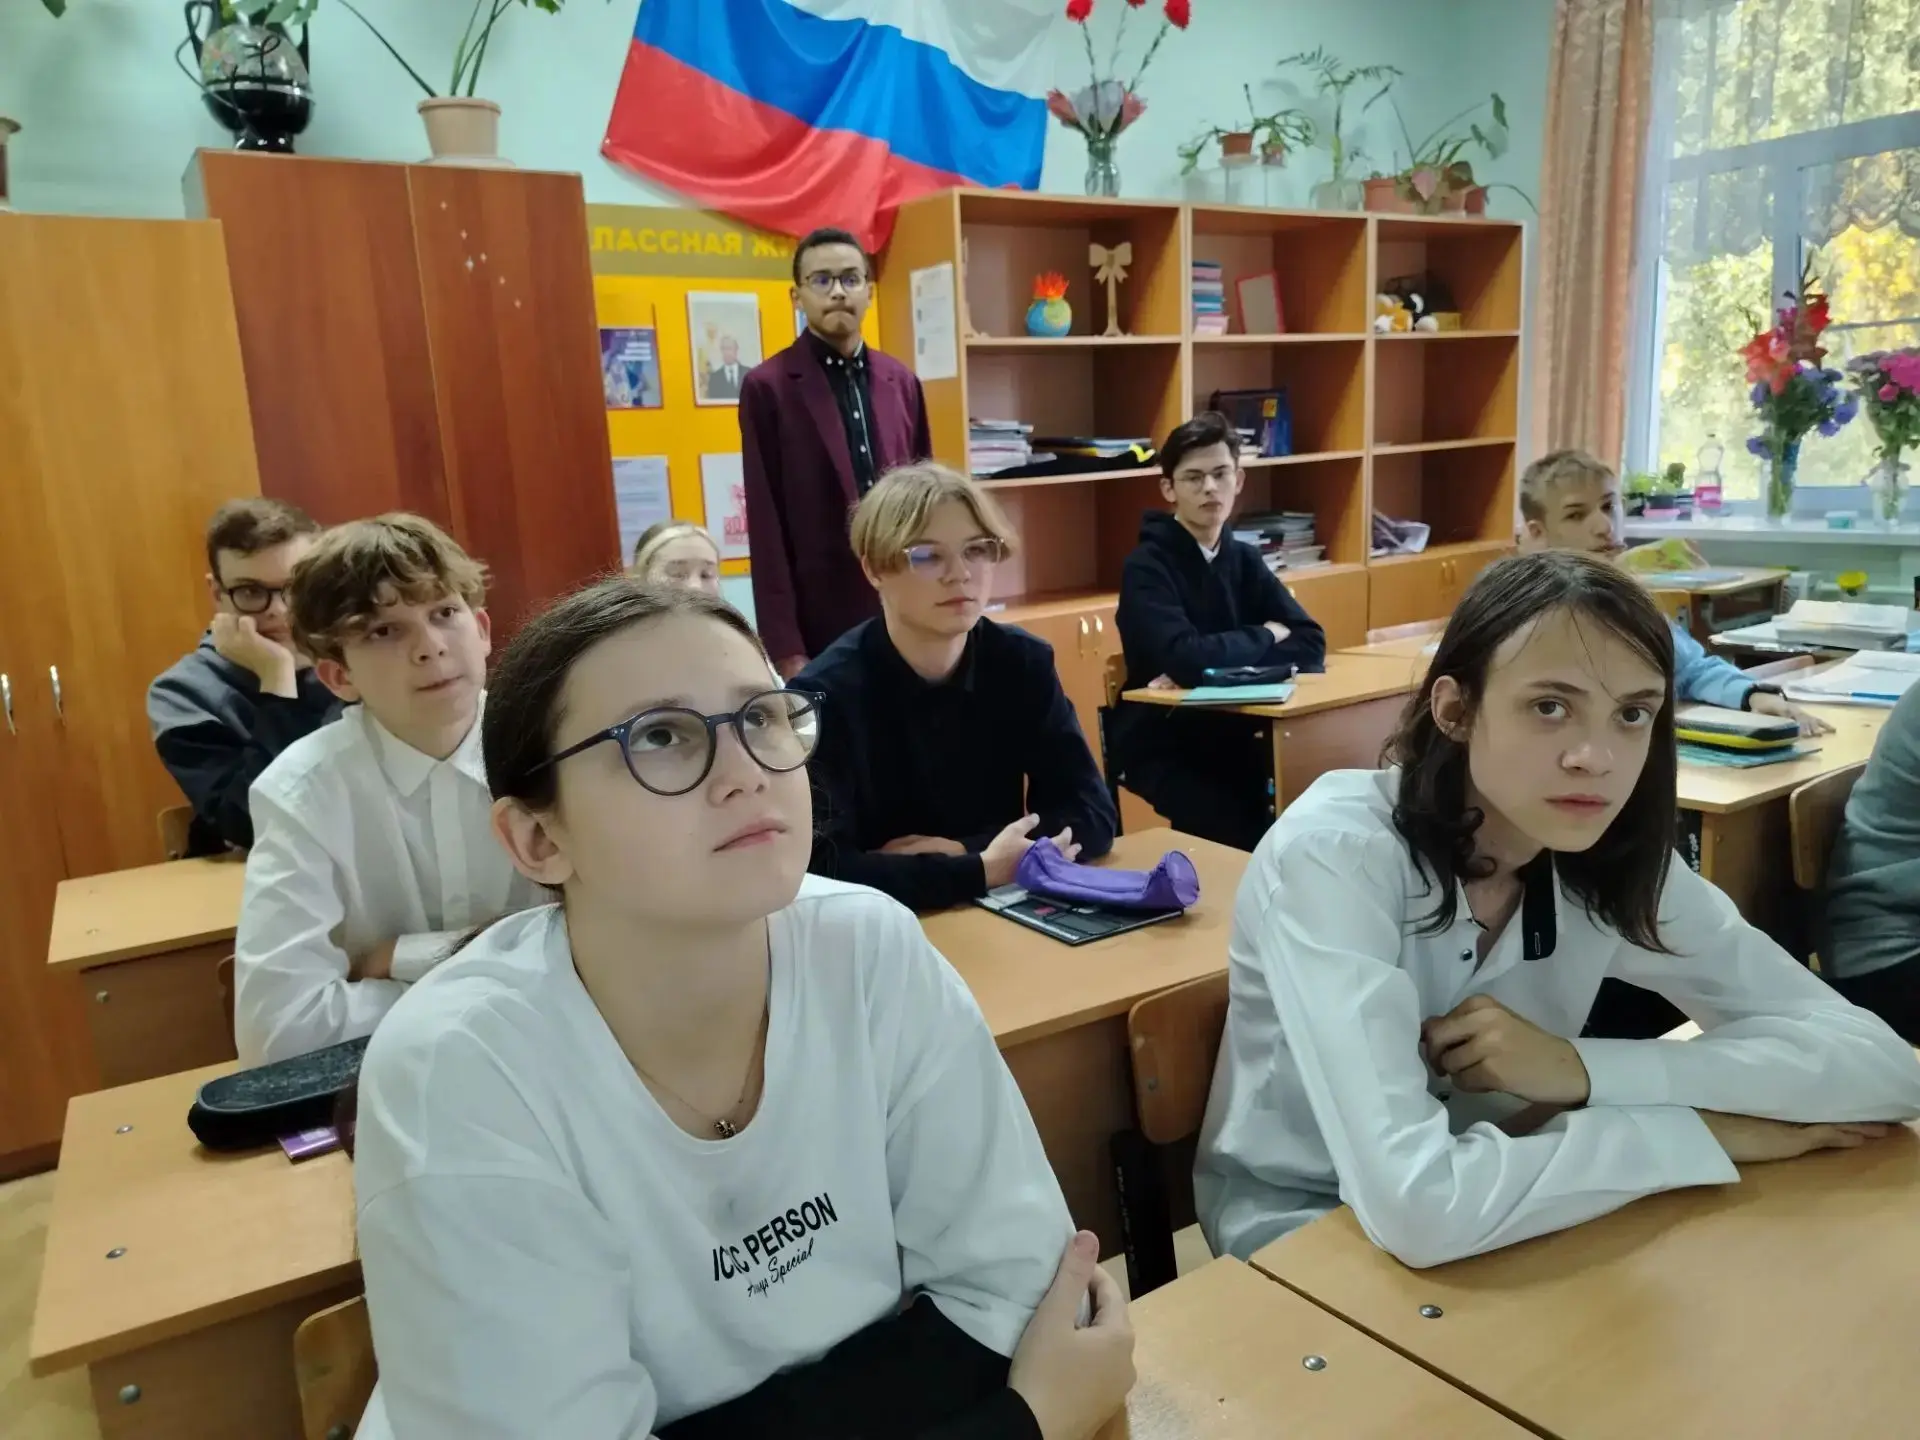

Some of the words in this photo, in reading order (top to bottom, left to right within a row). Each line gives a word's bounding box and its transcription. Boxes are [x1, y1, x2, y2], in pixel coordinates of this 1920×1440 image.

[592, 226, 744, 257] ЛАССНАЯ
[742, 1192, 838, 1265] PERSON
[767, 1236, 814, 1284] Special
